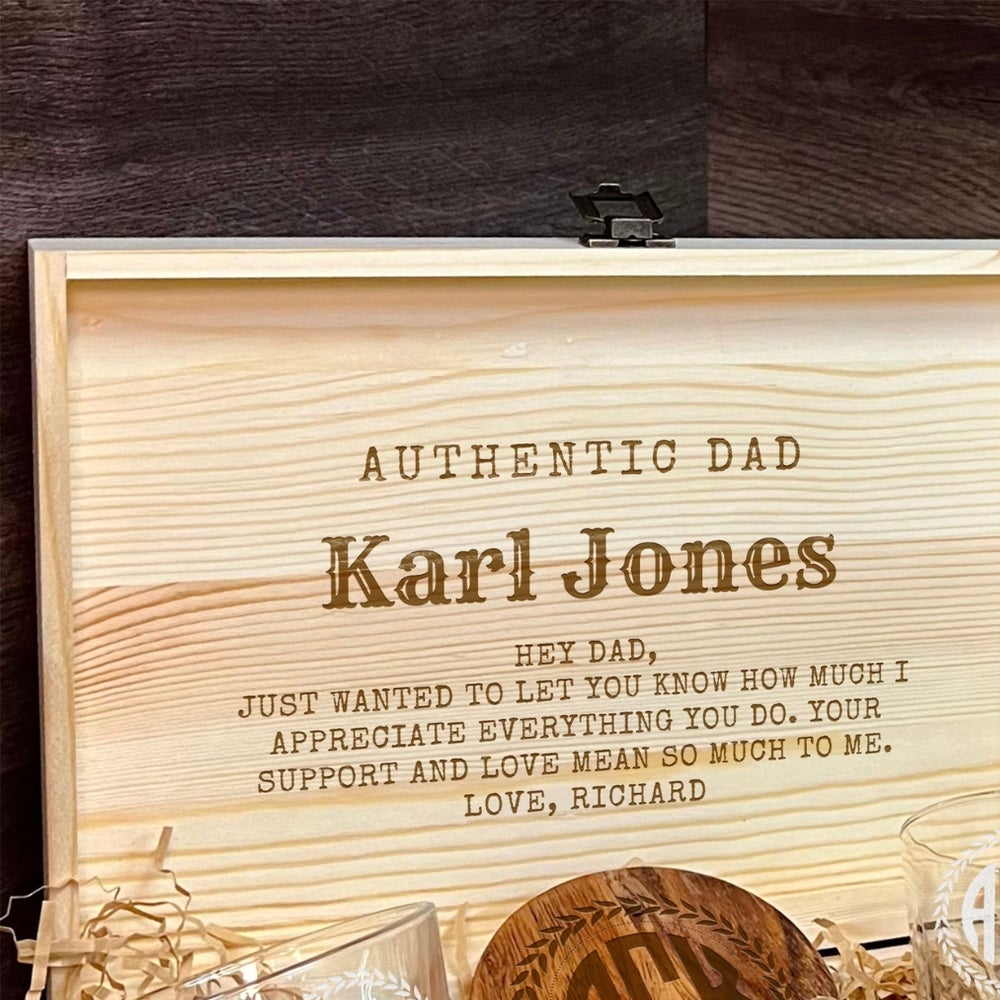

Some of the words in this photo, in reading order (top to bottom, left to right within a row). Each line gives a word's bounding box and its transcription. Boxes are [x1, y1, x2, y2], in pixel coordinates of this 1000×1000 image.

[359, 438, 679, 482] AUTHENTIC
[707, 435, 802, 472] DAD
[321, 527, 537, 609] Karl
[561, 526, 837, 599] Jones
[515, 640, 576, 667] HEY
[589, 638, 657, 666] DAD,
[238, 691, 318, 719] JUST
[331, 684, 453, 713] WANTED
[465, 681, 503, 706] TO
[515, 678, 574, 704] LET
[585, 674, 642, 699] YOU
[653, 670, 730, 696] KNOW
[740, 666, 798, 691] HOW
[809, 662, 885, 687] MUCH
[895, 660, 909, 682] I
[270, 721, 466, 755] APPRECIATE
[478, 709, 673, 743] EVERYTHING
[683, 705, 739, 730] YOU
[750, 702, 798, 727] DO.
[808, 697, 882, 722] YOUR
[257, 762, 398, 794] SUPPORT
[410, 757, 468, 784] AND
[480, 752, 559, 779] LOVE
[571, 746, 650, 773] MEAN
[661, 743, 698, 768] SO
[709, 738, 787, 765] MUCH
[796, 735, 833, 759] TO
[843, 732, 892, 756] ME.
[464, 789, 557, 818] LOVE,
[570, 779, 706, 810] RICHARD
